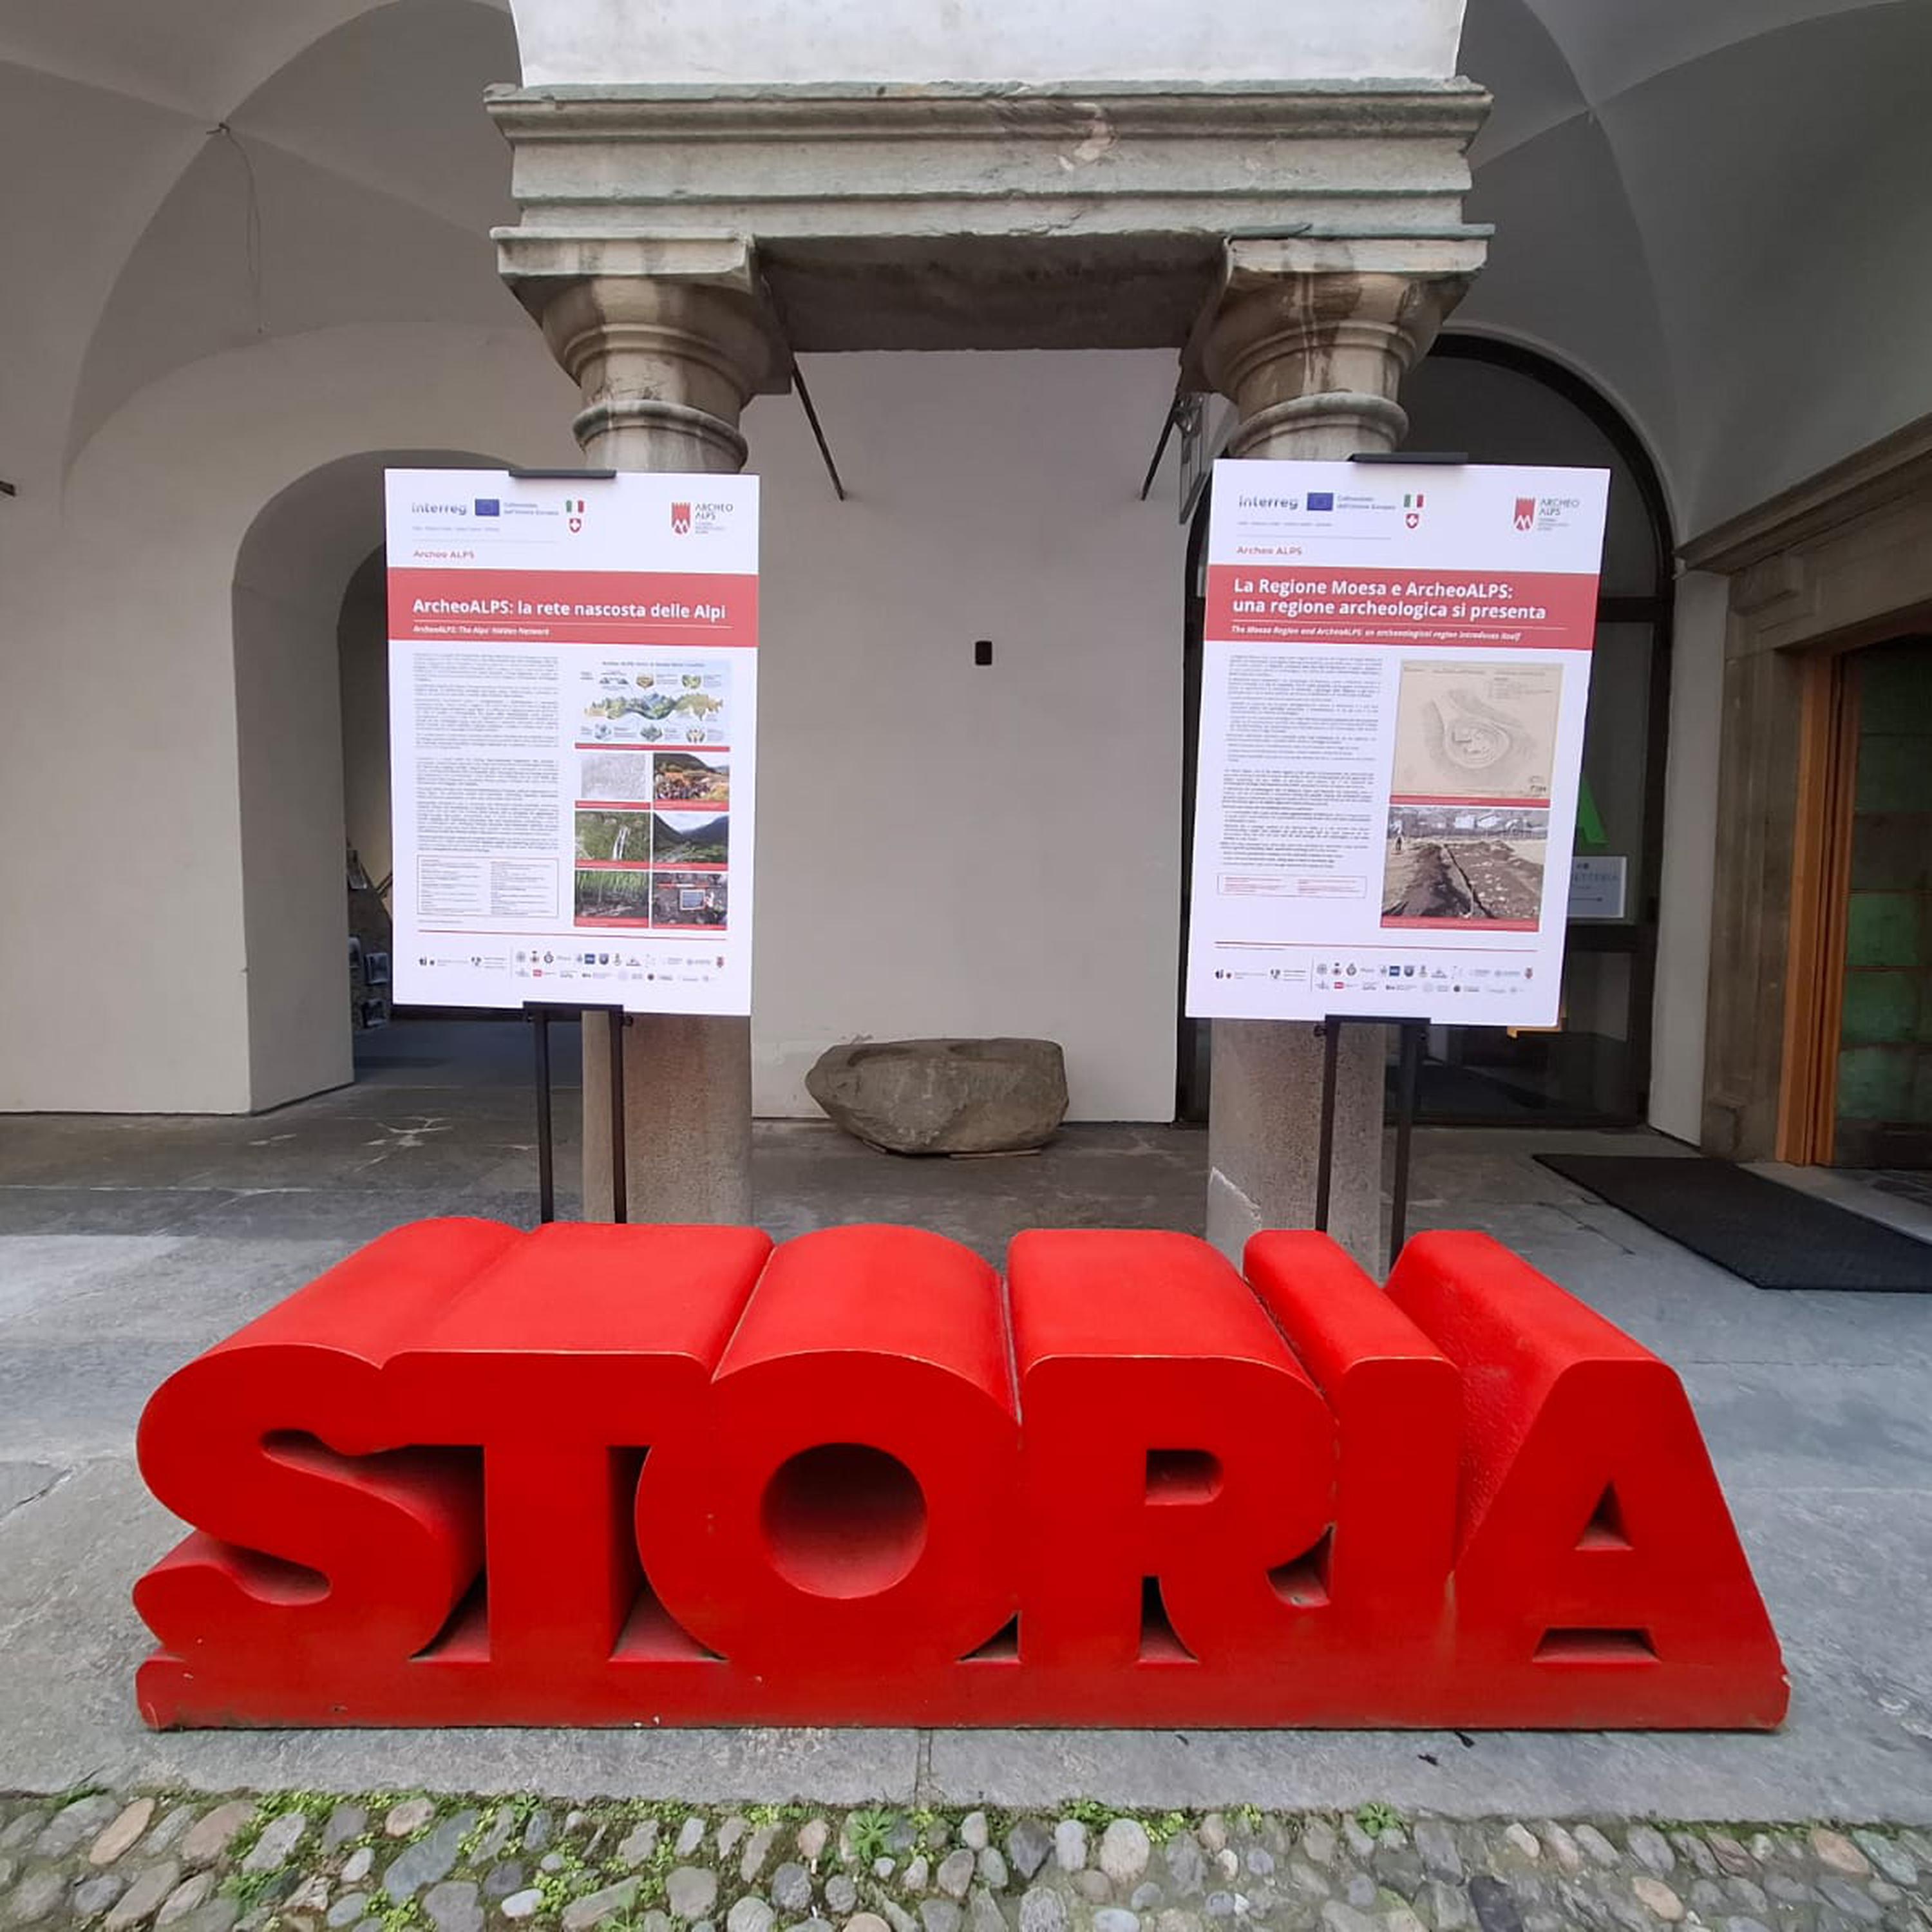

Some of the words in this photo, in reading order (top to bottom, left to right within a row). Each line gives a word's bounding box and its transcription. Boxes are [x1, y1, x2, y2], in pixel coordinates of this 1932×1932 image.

[1235, 578, 1253, 592] La
[1259, 579, 1327, 598] Regione
[1332, 581, 1386, 595] Moesa
[1392, 585, 1401, 596] e
[1406, 582, 1512, 598] ArcheoALPS:
[413, 599, 513, 614] ArcheoALPS:
[518, 600, 531, 614] la
[538, 603, 570, 615] rete
[575, 605, 645, 617] nascosta
[651, 603, 690, 618] delle
[694, 605, 725, 622] Alpi
[1233, 601, 1265, 612] una
[1271, 599, 1334, 617] regione
[1340, 600, 1447, 620] archeologica
[1452, 603, 1465, 617] si
[1470, 607, 1546, 621] presenta
[1273, 627, 1298, 636] Region
[134, 1345, 1786, 1726] STORIA
